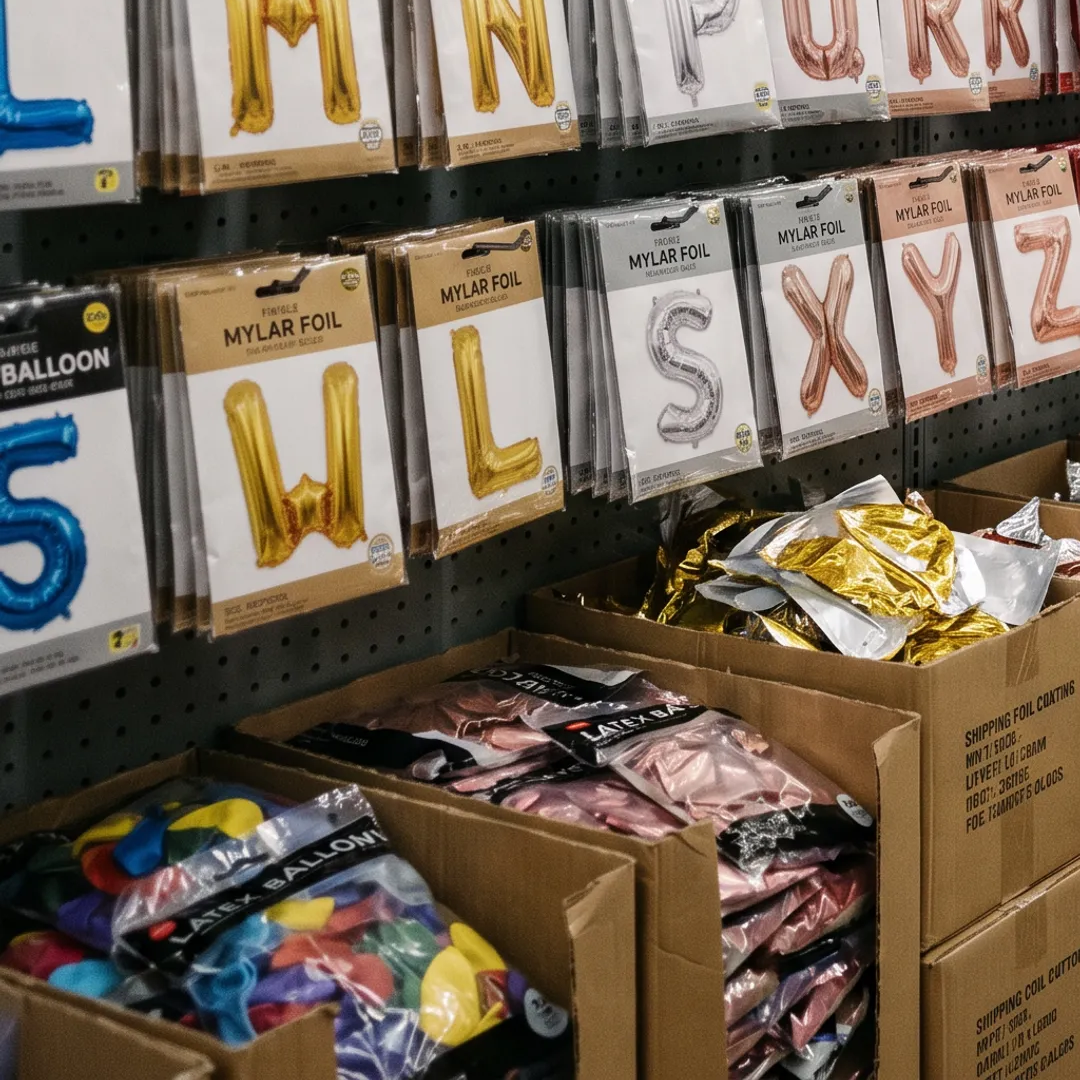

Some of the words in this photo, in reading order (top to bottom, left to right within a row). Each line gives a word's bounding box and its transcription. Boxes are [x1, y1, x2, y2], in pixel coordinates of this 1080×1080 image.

[895, 206, 930, 223] MYLAR
[931, 198, 953, 214] FOIL
[1006, 190, 1036, 205] MYLAR
[1040, 183, 1062, 198] FOIL
[778, 226, 817, 246] MYLAR
[820, 220, 845, 237] FOIL
[629, 250, 677, 271] MYLAR
[680, 243, 710, 261] FOIL
[441, 282, 489, 305] MYLAR
[492, 271, 522, 291] FOIL
[902, 231, 961, 377] Y
[224, 322, 295, 348] MYLAR
[300, 311, 342, 333] FOIL
[781, 254, 869, 418] X
[1, 346, 110, 386] BALLOON
[646, 288, 724, 449] S
[450, 324, 543, 501] L
[223, 360, 368, 569] W
[579, 710, 656, 743] LATEX
[965, 711, 1011, 748] SHIPPING
[1013, 700, 1035, 724] FOIL
[169, 893, 263, 944] LATEX
[1025, 975, 1046, 1001] COIL
